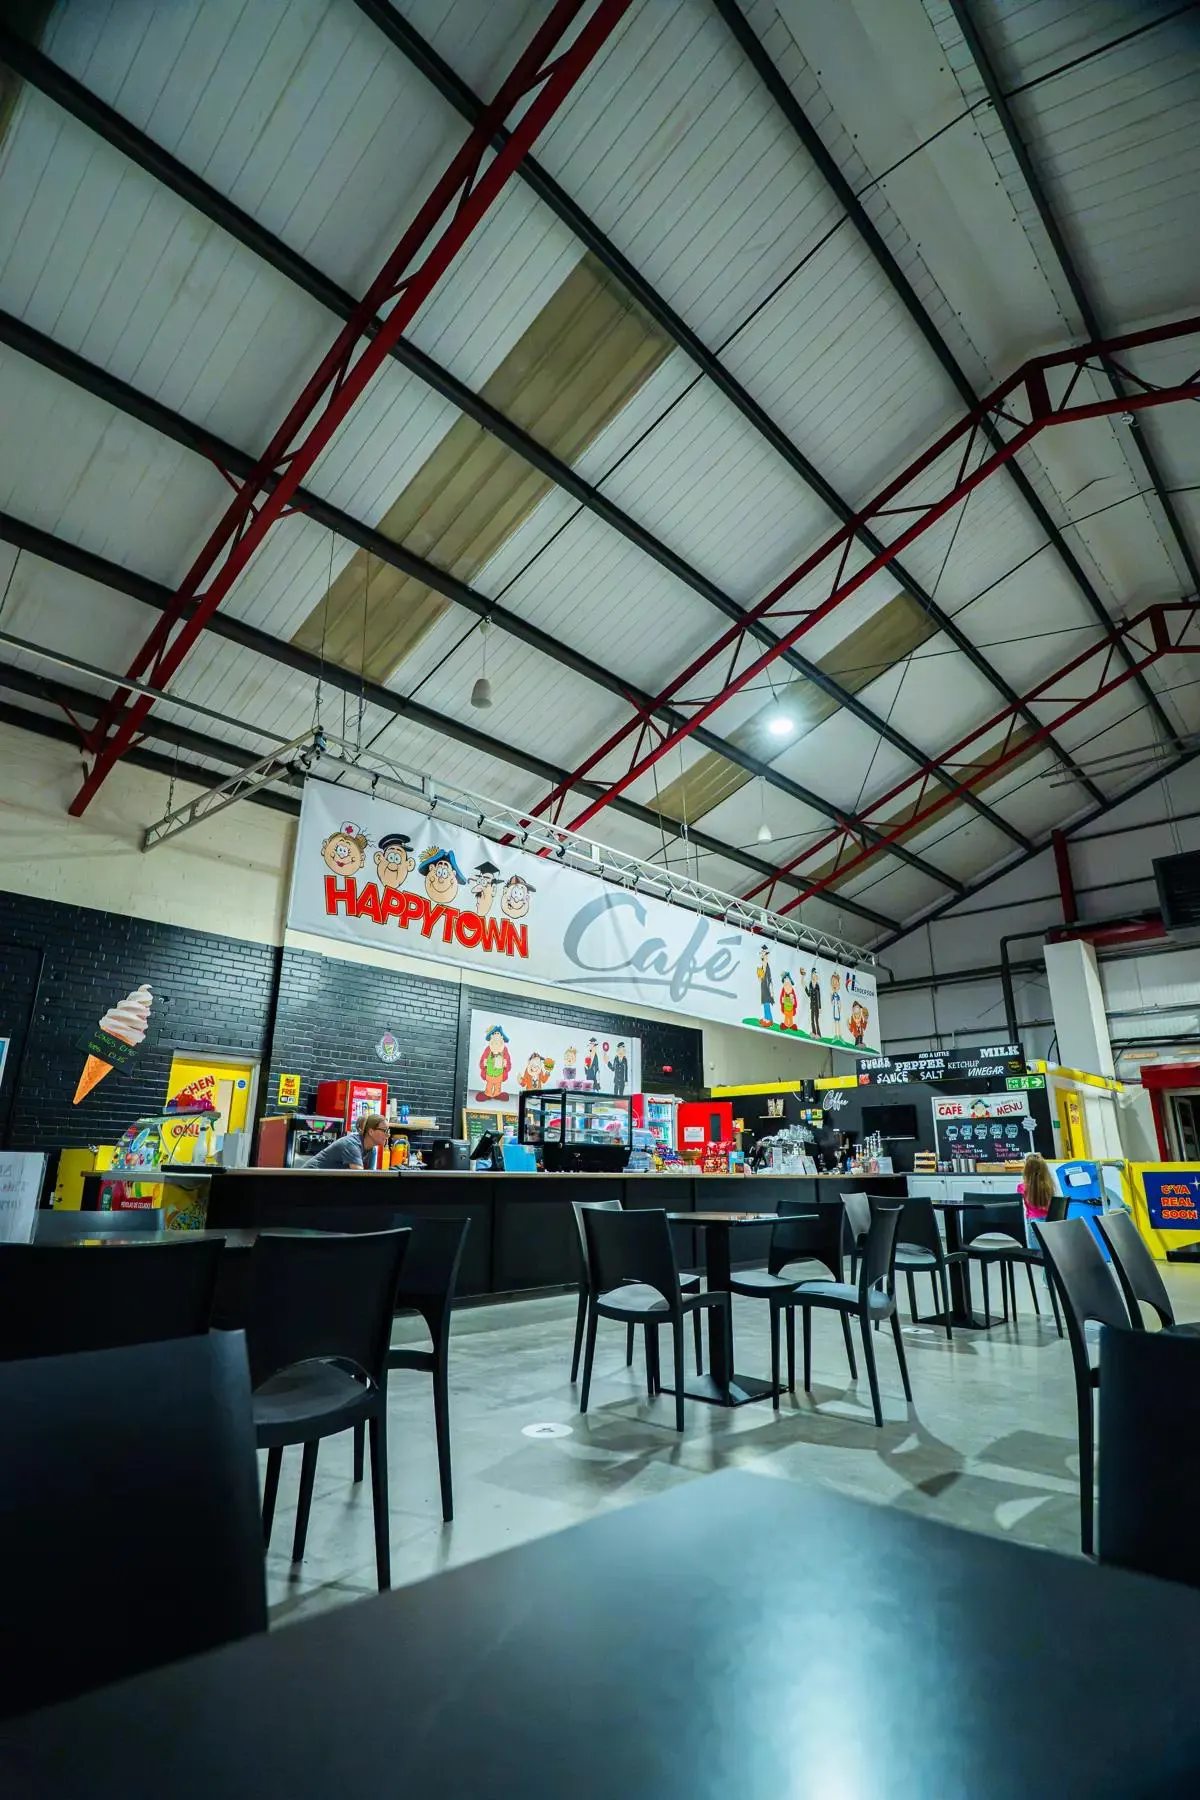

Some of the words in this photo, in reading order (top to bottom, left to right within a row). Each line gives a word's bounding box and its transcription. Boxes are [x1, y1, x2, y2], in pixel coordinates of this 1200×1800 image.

[324, 874, 529, 958] HAPPYTOWN
[562, 892, 742, 1003] Café
[934, 1050, 950, 1058] LITTLE
[980, 1045, 1020, 1059] MILK
[894, 1058, 945, 1072] PEPPER
[947, 1060, 980, 1070] KETCHUP
[967, 1065, 1004, 1077] VINEGAR
[876, 1071, 909, 1084] SAUCE
[919, 1070, 945, 1081] SALT
[281, 1088, 297, 1096] FREE
[938, 1103, 963, 1116] CAFÉ
[996, 1101, 1023, 1116] MENU
[171, 1123, 199, 1138] ONL
[1161, 1184, 1191, 1194] C'YA
[1161, 1197, 1195, 1207] REAL
[1162, 1209, 1198, 1219] SOON
